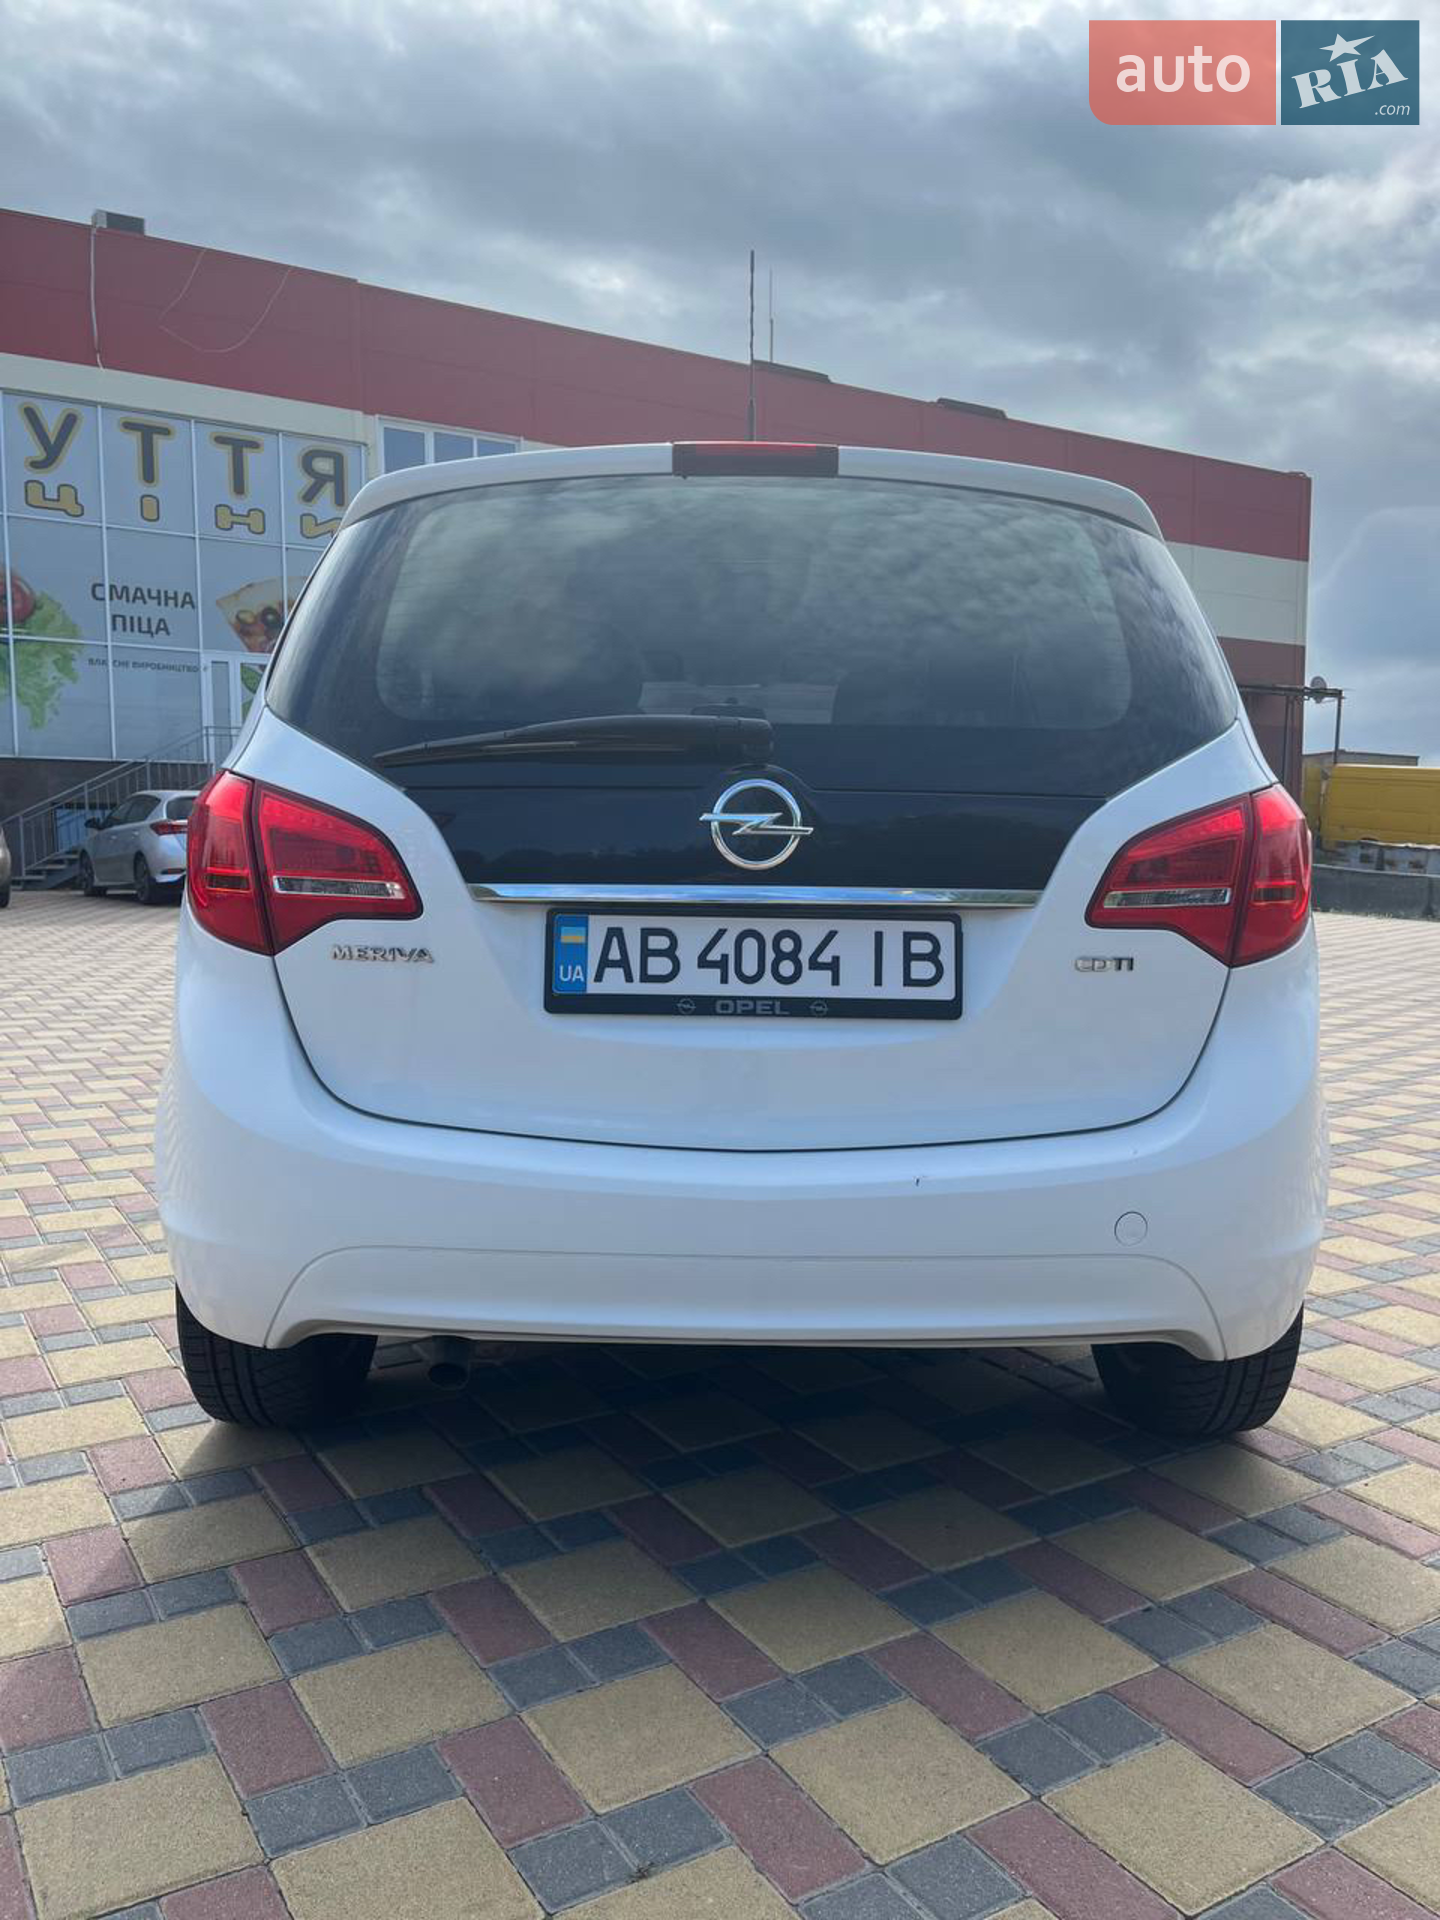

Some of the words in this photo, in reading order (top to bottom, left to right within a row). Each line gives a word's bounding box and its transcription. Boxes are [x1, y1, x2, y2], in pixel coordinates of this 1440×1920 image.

[91, 583, 196, 609] СМАЧНА
[111, 614, 171, 638] ПІЦА
[332, 945, 434, 963] MERIVA
[593, 926, 681, 984] AB
[697, 928, 841, 987] 4084
[1075, 956, 1134, 972] CDTI
[559, 966, 585, 983] UA
[714, 999, 790, 1016] OPEL
